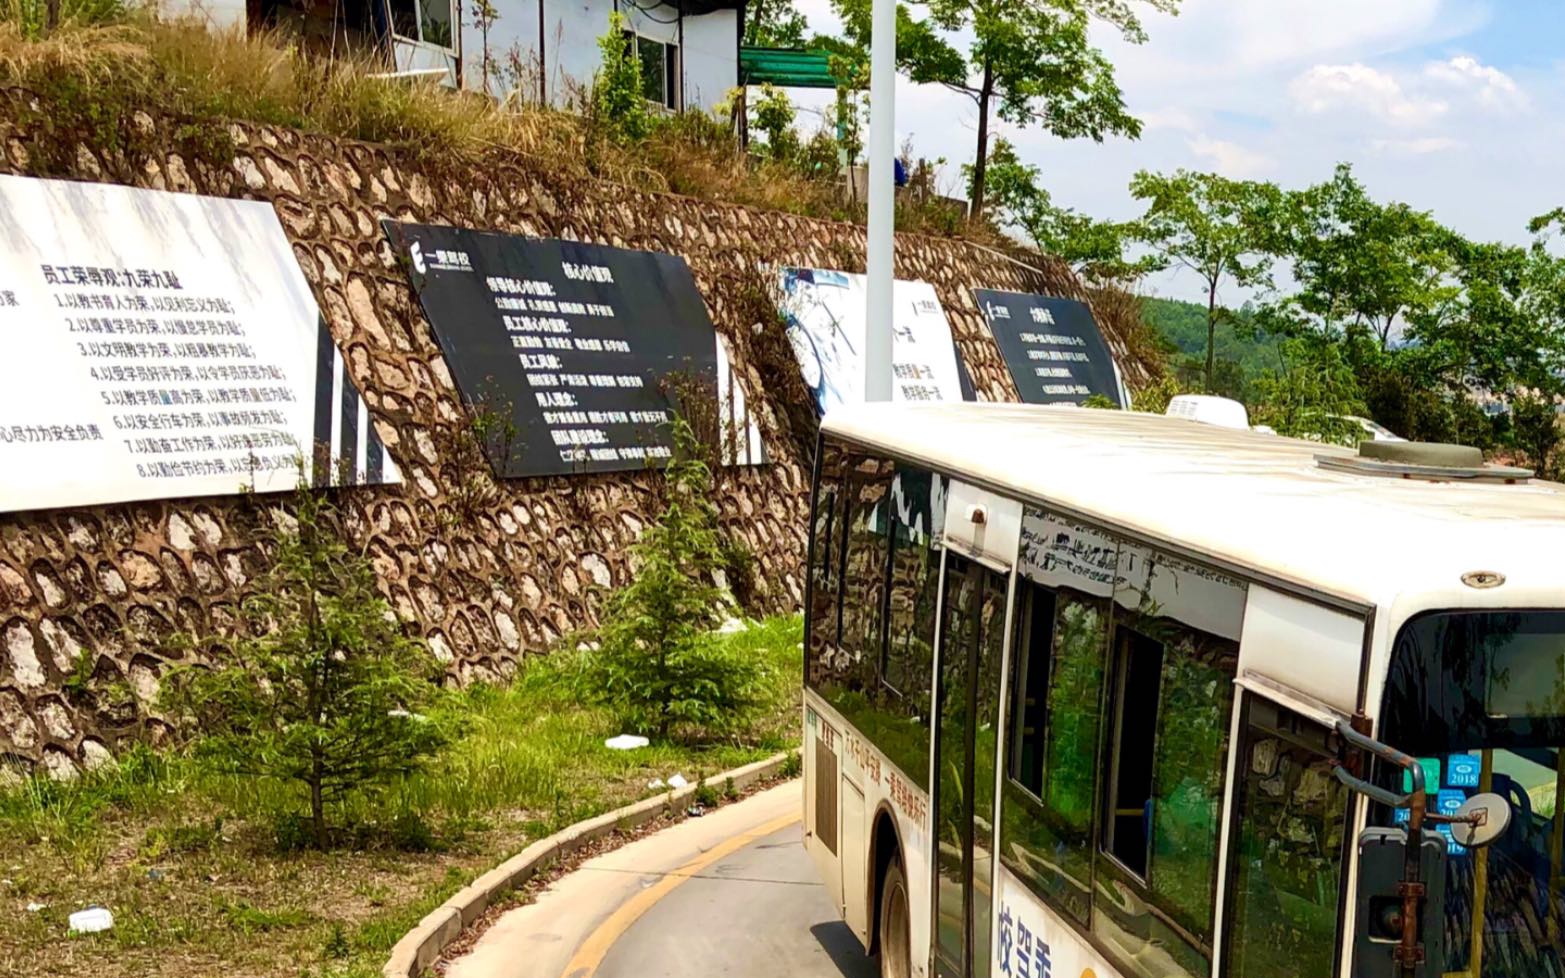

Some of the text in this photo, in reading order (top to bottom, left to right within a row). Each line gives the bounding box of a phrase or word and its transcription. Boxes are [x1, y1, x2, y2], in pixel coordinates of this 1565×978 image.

[41, 264, 184, 290] 员工荣辱观:九荣九耻
[1451, 773, 1477, 788] 2018
